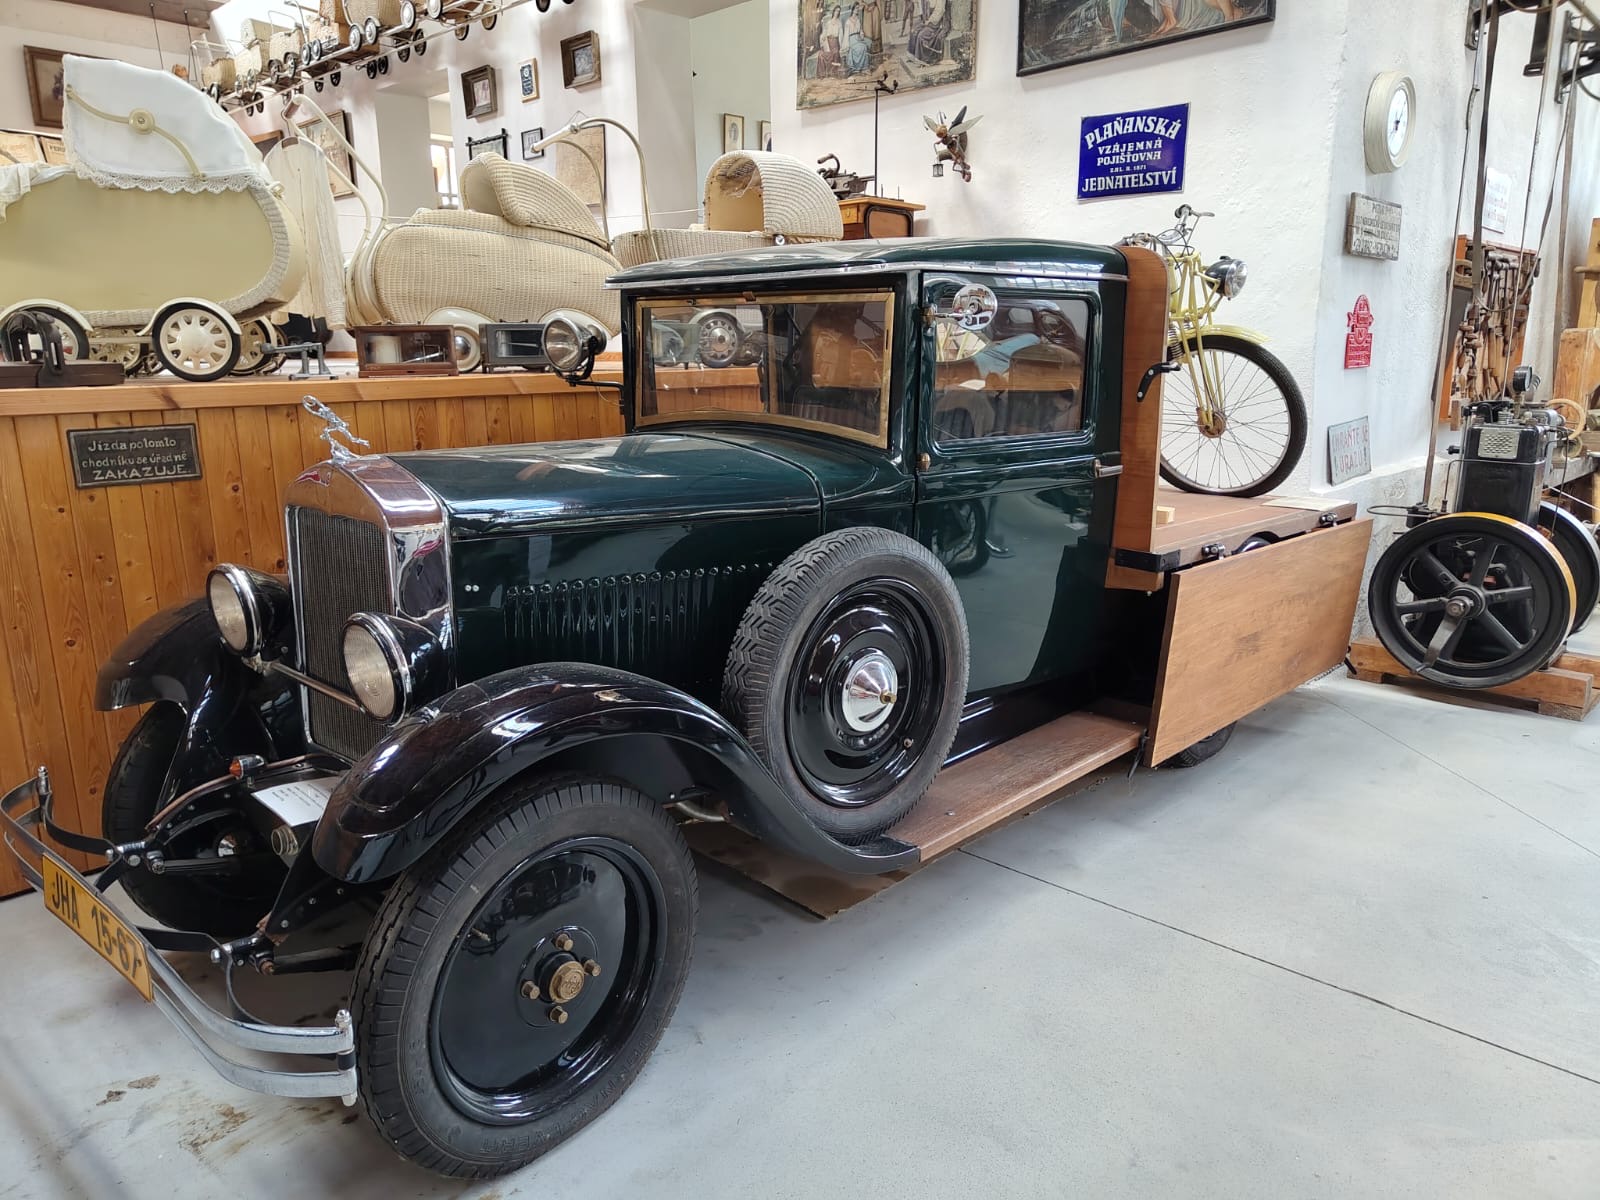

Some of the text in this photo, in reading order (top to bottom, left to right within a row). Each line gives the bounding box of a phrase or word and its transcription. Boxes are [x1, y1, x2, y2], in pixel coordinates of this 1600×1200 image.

[1084, 116, 1182, 150] PLAŇANSKÁ
[1098, 137, 1163, 155] VZÁJEMNÁ
[1097, 151, 1162, 166] POJIŠŤOVNA
[1082, 167, 1177, 192] JEDNATELSTVÍ
[136, 456, 148, 464] se
[51, 871, 138, 979] JHA 15-67
